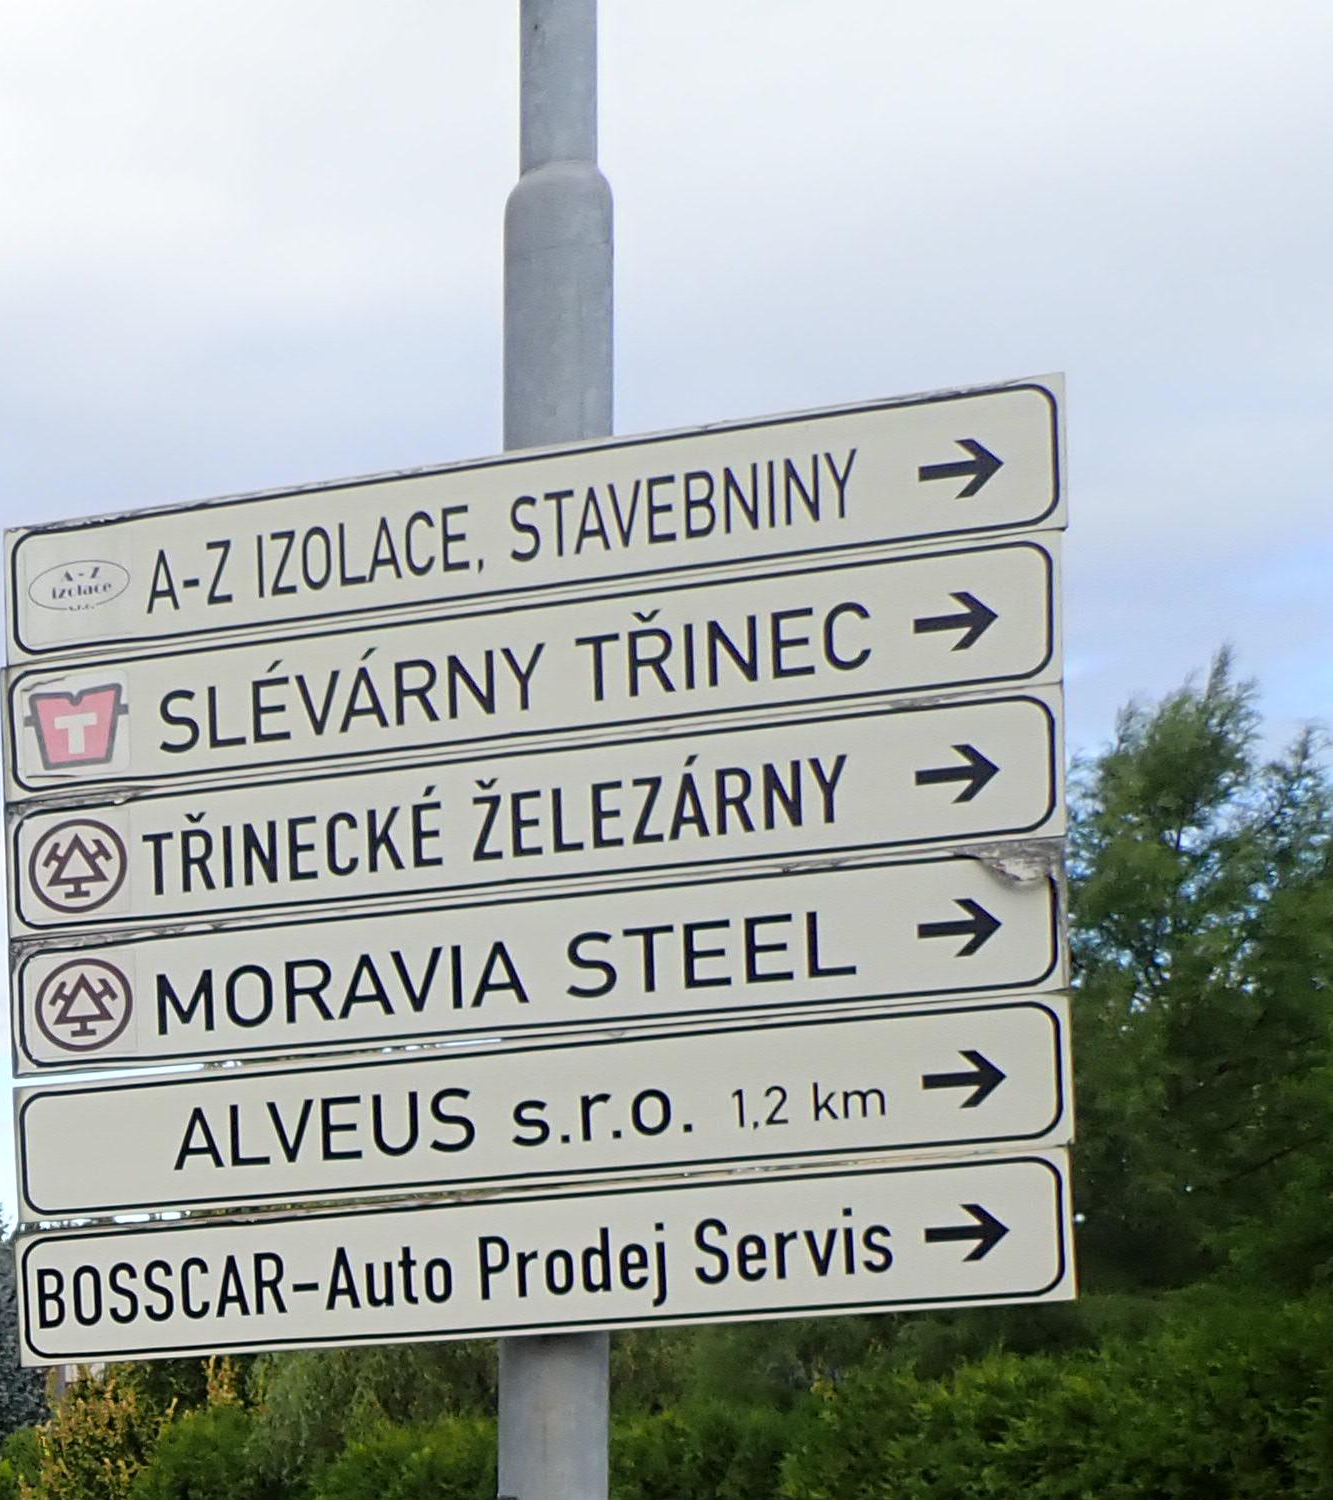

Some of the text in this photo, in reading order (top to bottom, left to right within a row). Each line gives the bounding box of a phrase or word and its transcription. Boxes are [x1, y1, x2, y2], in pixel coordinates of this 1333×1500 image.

[147, 448, 857, 614] A-Z IZOLACE, STAVEBNINY
[159, 601, 872, 754] SLÉVÁRNY TŘINEC
[141, 754, 847, 896] TŘINECKÉ ŽELEZÁRNY
[156, 911, 857, 1036] MORAVIA STEEL
[173, 1081, 886, 1171] ALVEUS s.r.o. 1,2 km
[478, 1222, 668, 1308] Prodej
[694, 1207, 894, 1285] Servis
